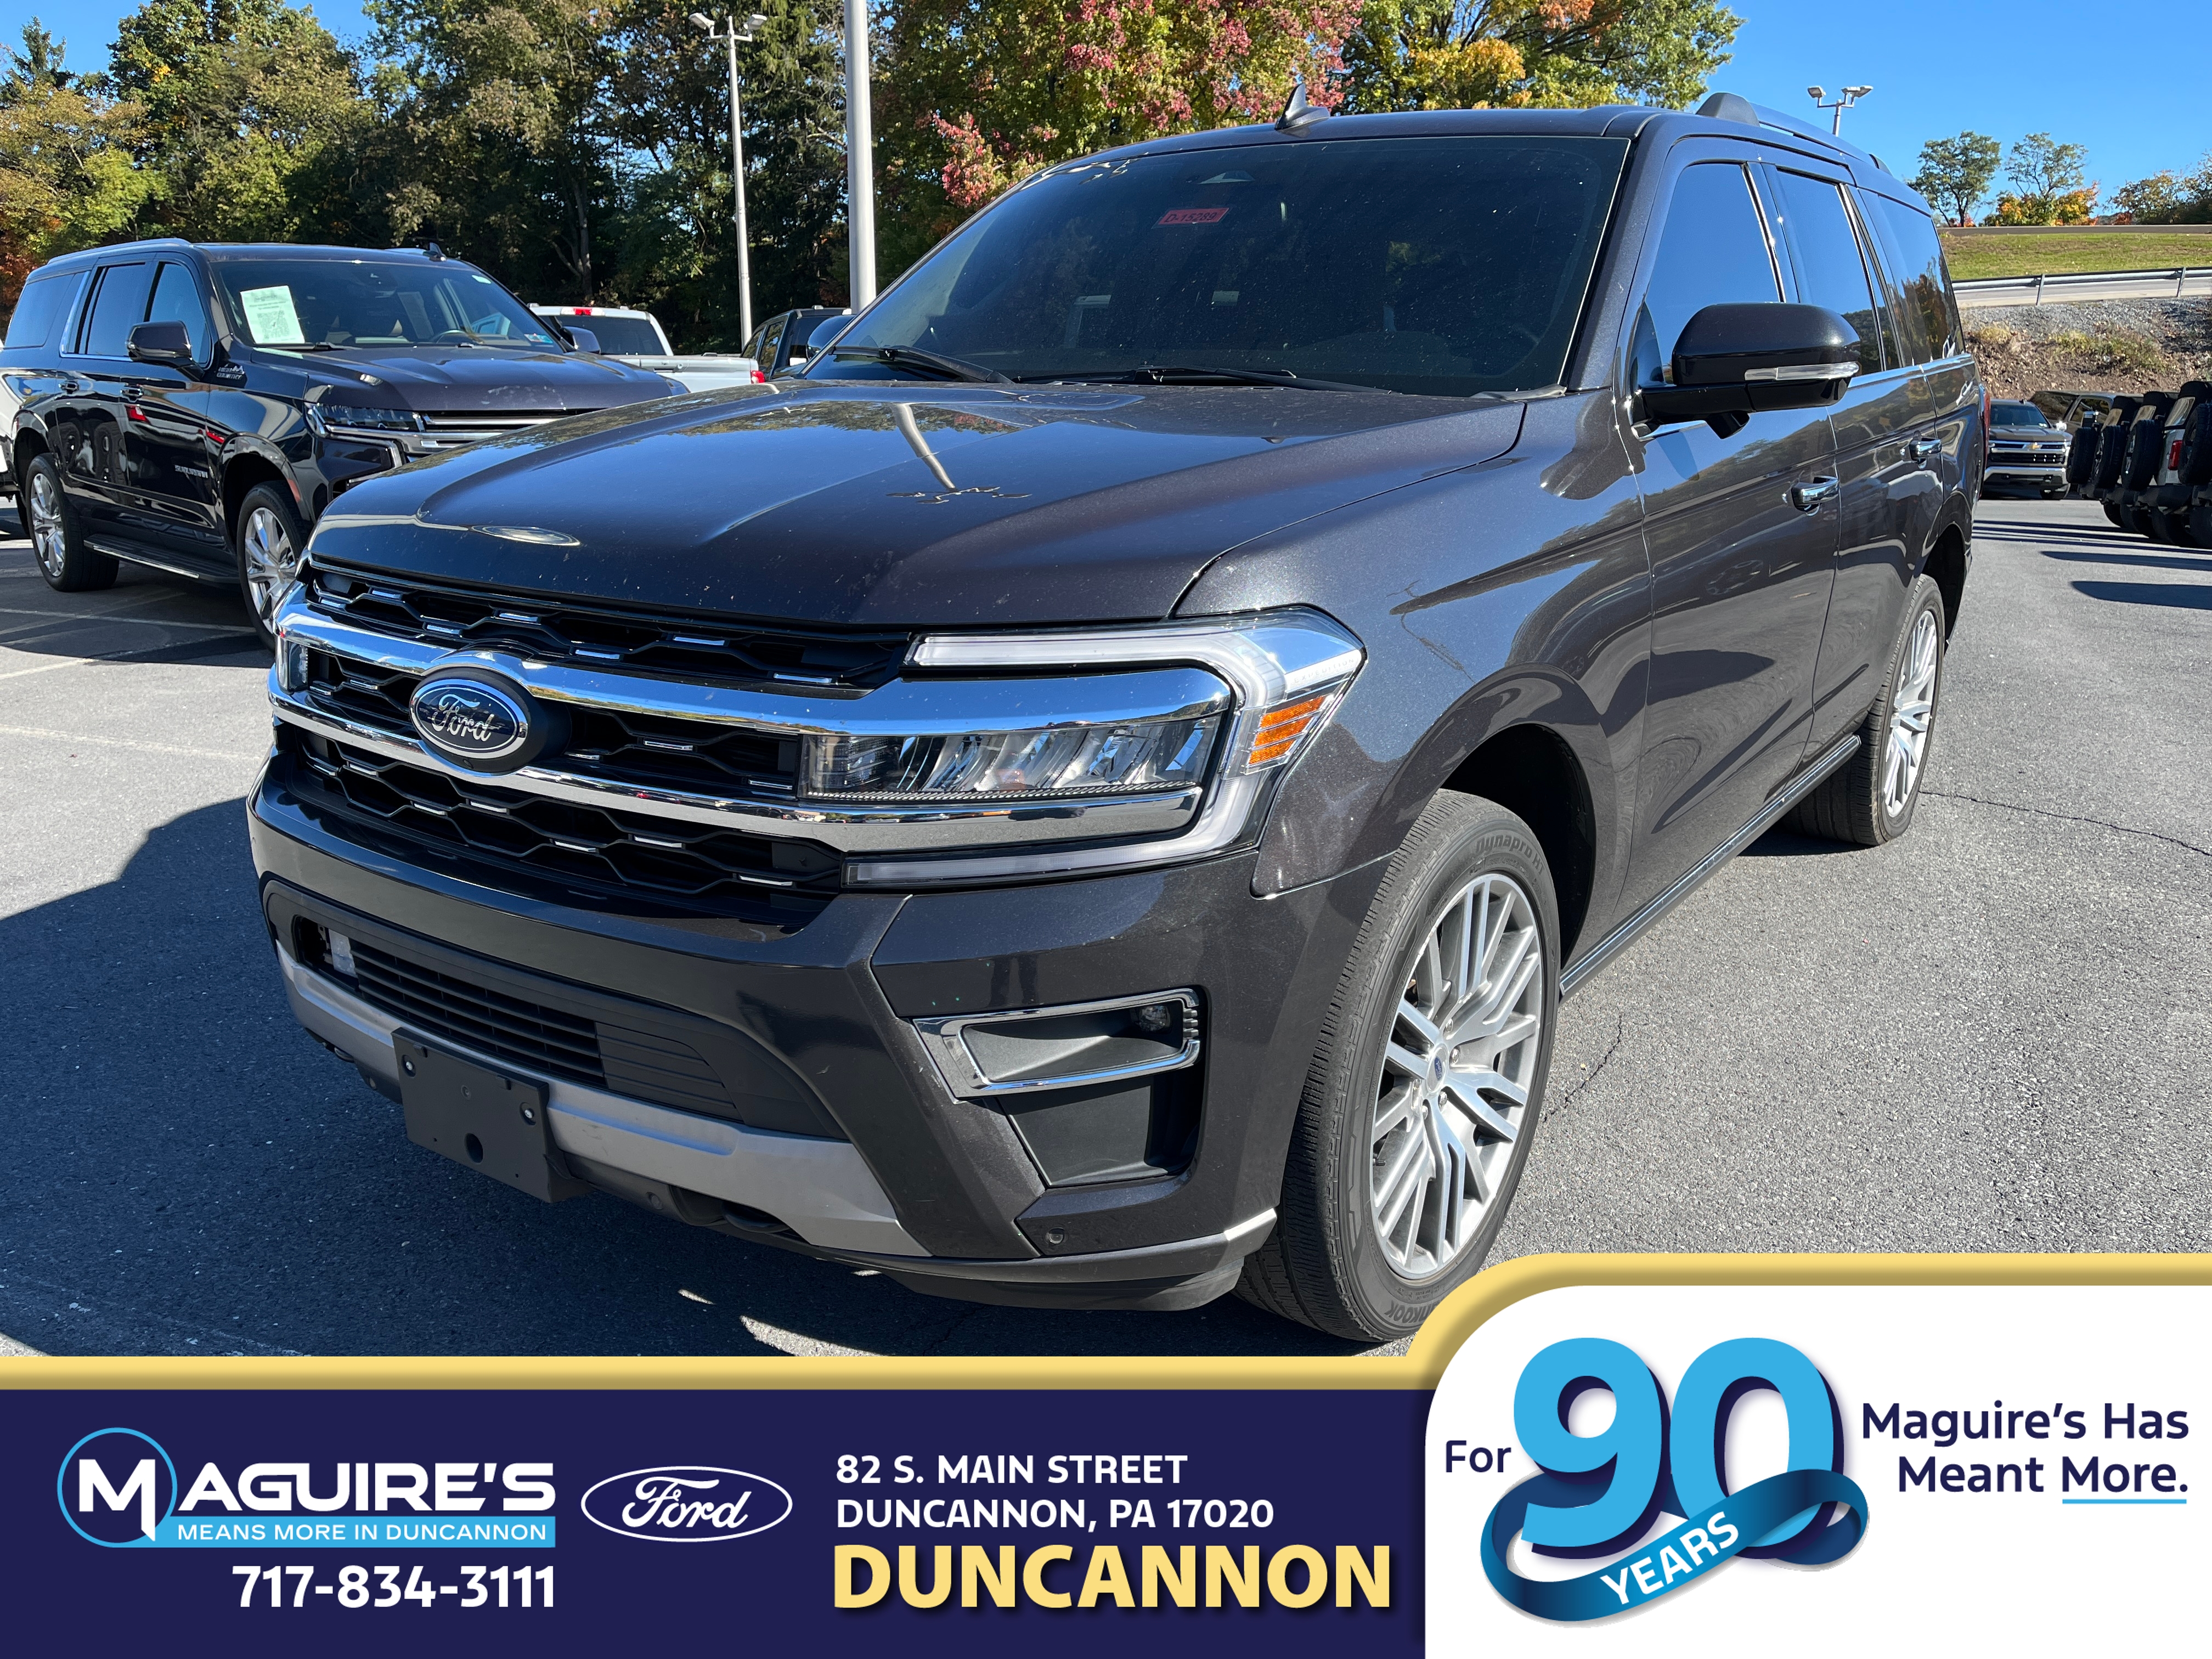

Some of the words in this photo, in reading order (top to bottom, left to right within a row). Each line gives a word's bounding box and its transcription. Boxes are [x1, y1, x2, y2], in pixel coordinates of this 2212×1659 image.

[1164, 212, 1218, 223] D-15289
[428, 693, 495, 742] Ford
[1532, 853, 1545, 876] HT
